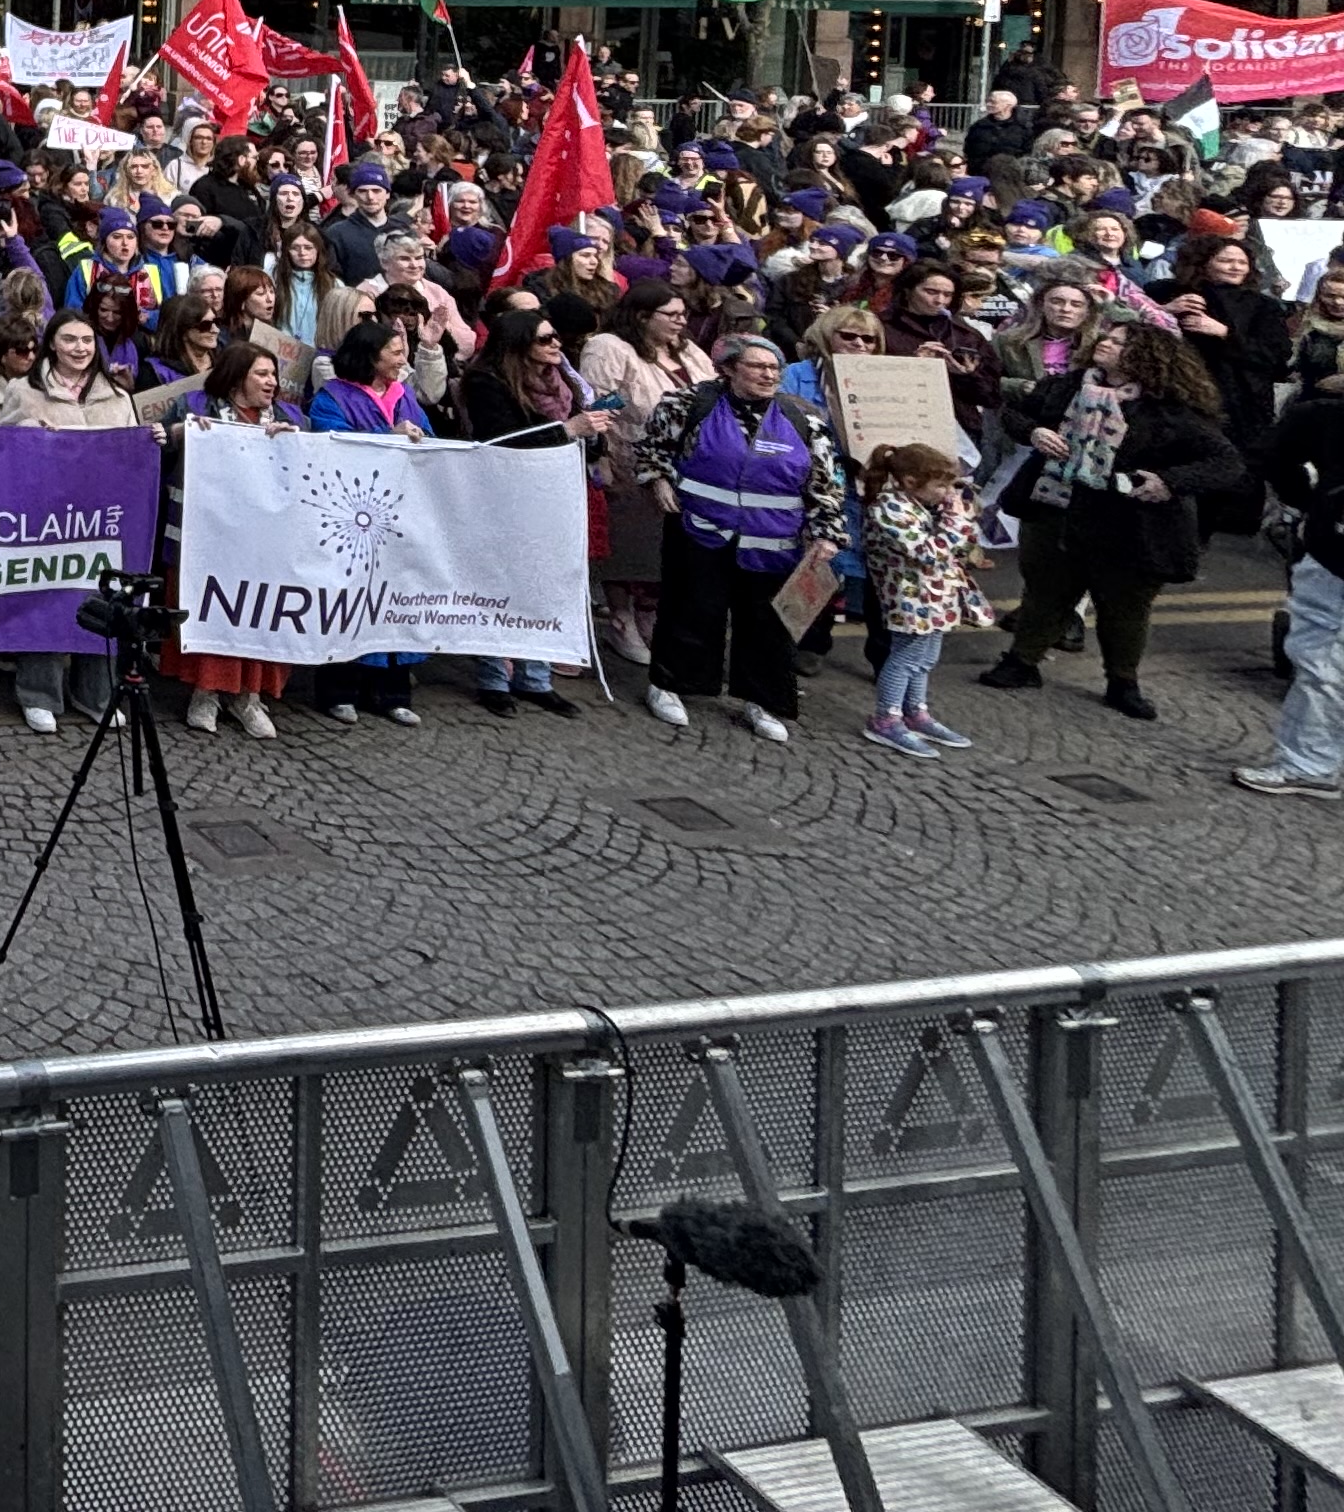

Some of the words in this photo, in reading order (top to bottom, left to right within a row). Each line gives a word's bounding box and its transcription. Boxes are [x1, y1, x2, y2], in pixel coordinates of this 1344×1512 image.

[186, 11, 235, 66] unit
[698, 16, 742, 41] IV
[105, 504, 124, 536] the
[198, 575, 388, 640] NIRWN
[388, 590, 448, 608] Northern
[452, 590, 511, 610] Ireland
[382, 609, 421, 626] Rural
[424, 609, 489, 627] Women's
[493, 611, 564, 634] Network
